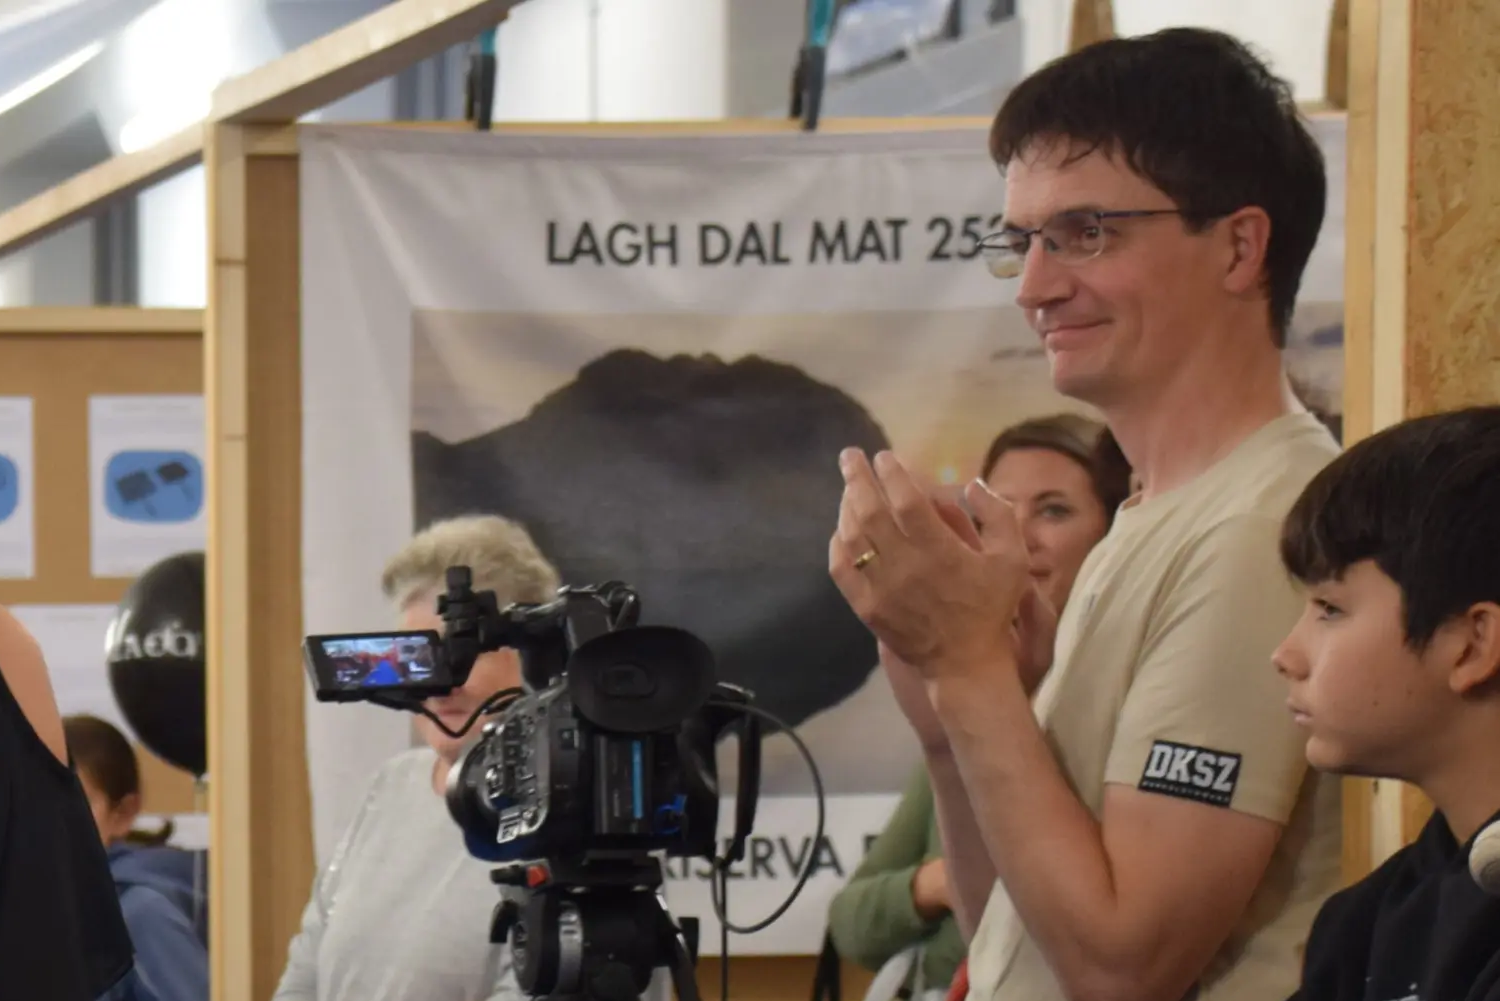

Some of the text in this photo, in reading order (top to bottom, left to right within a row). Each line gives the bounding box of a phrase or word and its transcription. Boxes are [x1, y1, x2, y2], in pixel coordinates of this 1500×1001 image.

[546, 219, 678, 266] LAGH
[698, 220, 790, 266] DAL
[807, 217, 908, 265] MAT
[1144, 743, 1238, 793] DKSZ
